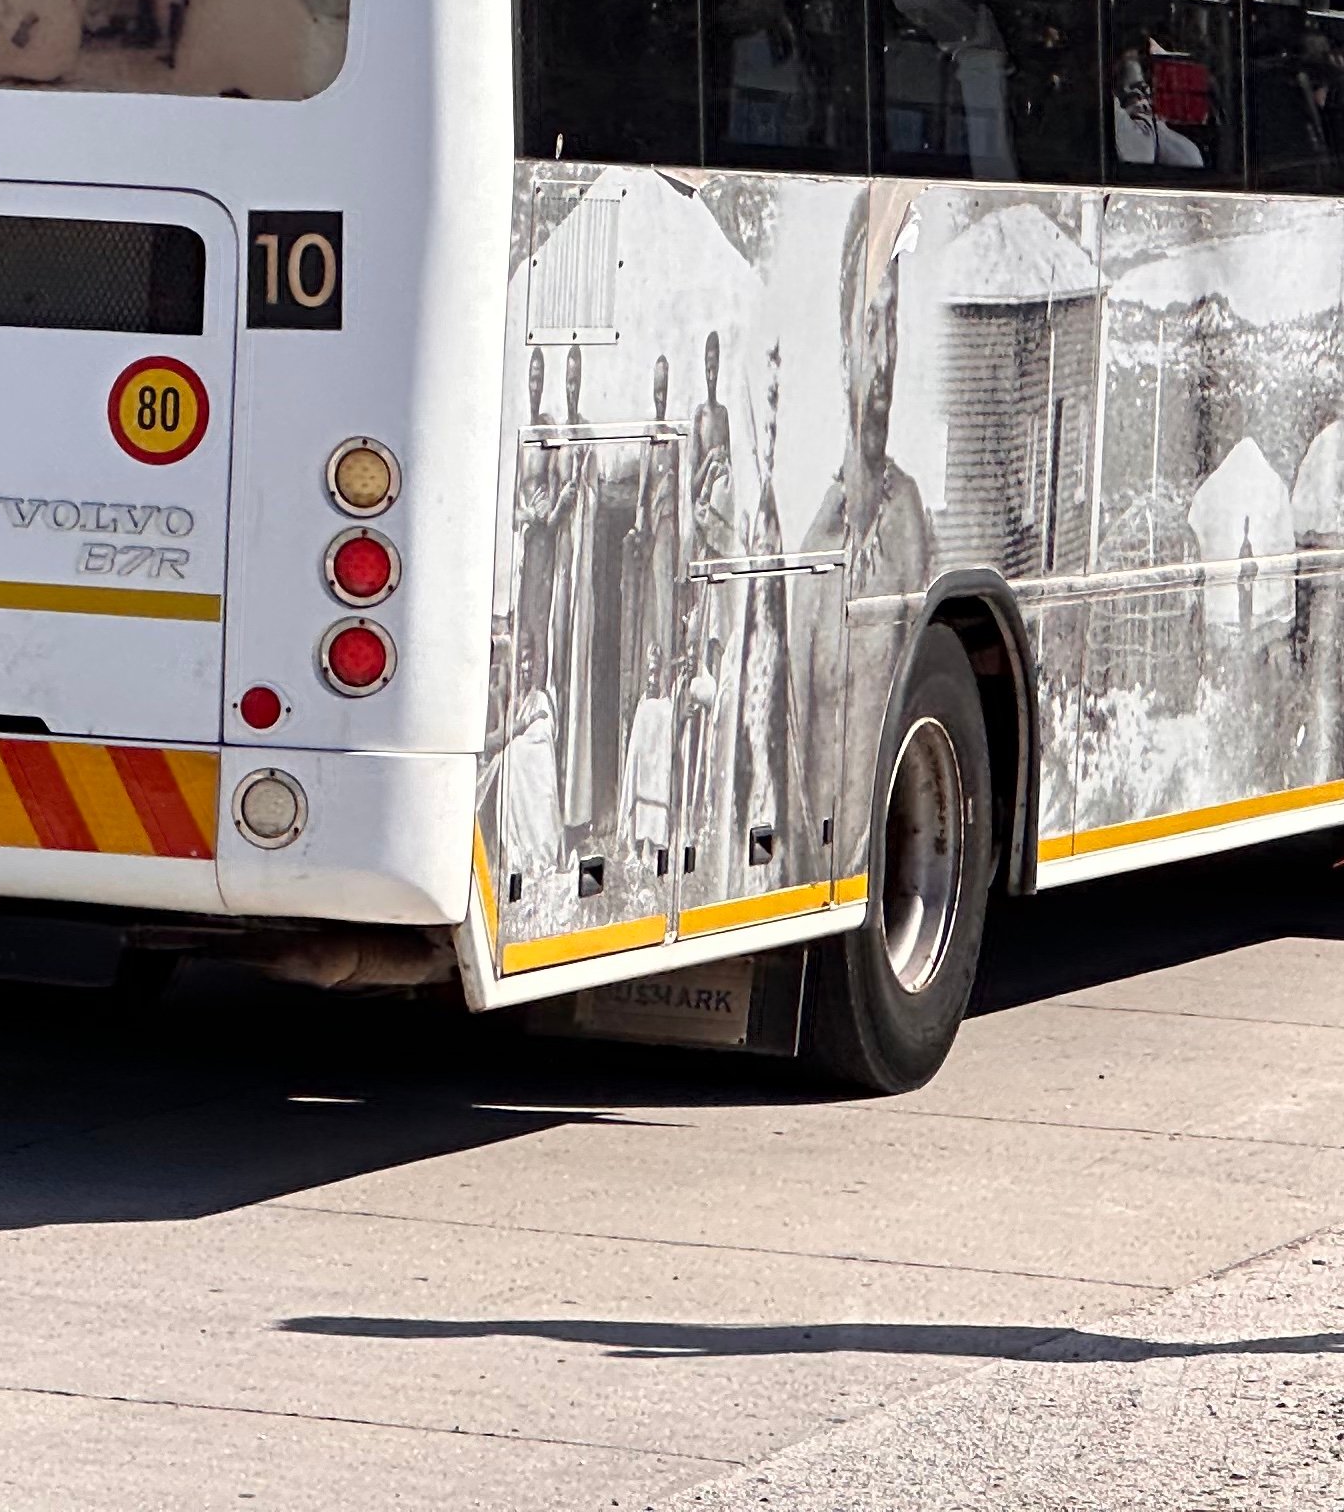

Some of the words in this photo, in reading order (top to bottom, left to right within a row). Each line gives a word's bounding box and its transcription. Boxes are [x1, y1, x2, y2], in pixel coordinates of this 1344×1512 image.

[256, 233, 337, 308] 10
[137, 385, 180, 432] 80
[77, 541, 191, 580] B7R
